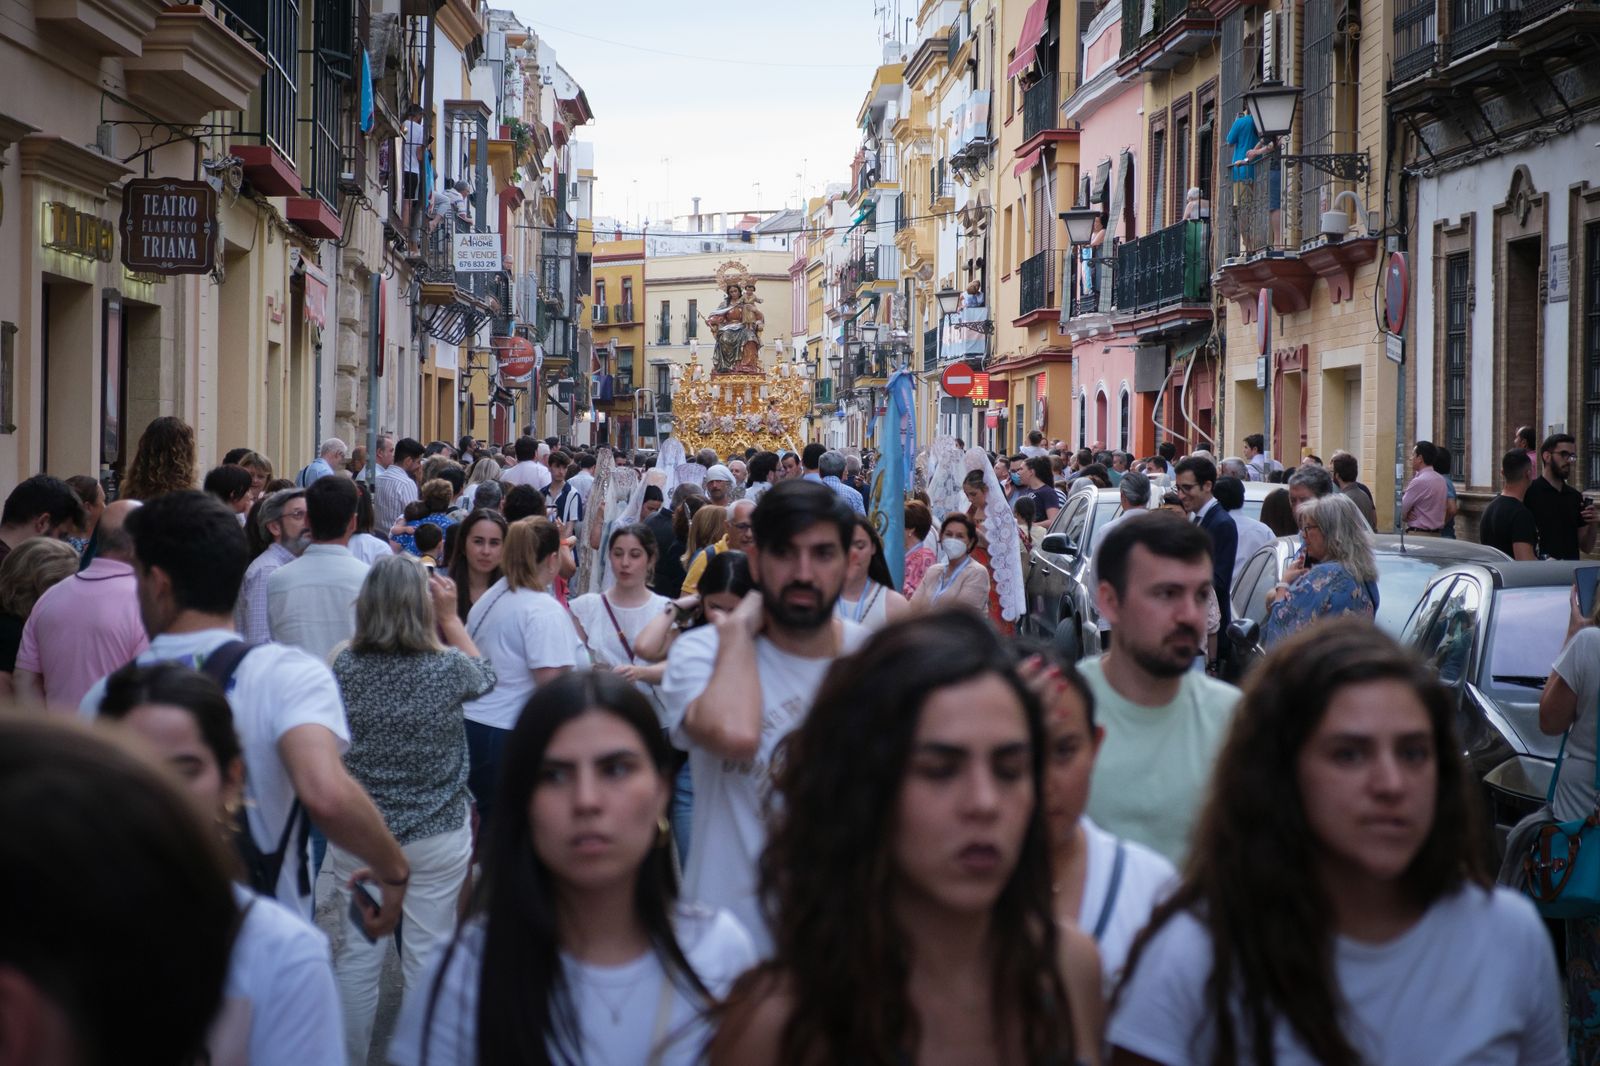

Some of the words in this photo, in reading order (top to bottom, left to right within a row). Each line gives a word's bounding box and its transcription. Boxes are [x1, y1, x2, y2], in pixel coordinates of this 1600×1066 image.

[143, 194, 197, 217] TEATRO
[142, 219, 197, 234] FLAMENCO
[142, 236, 196, 259] TRIANA
[457, 251, 468, 259] SE
[470, 251, 498, 259] VENDE
